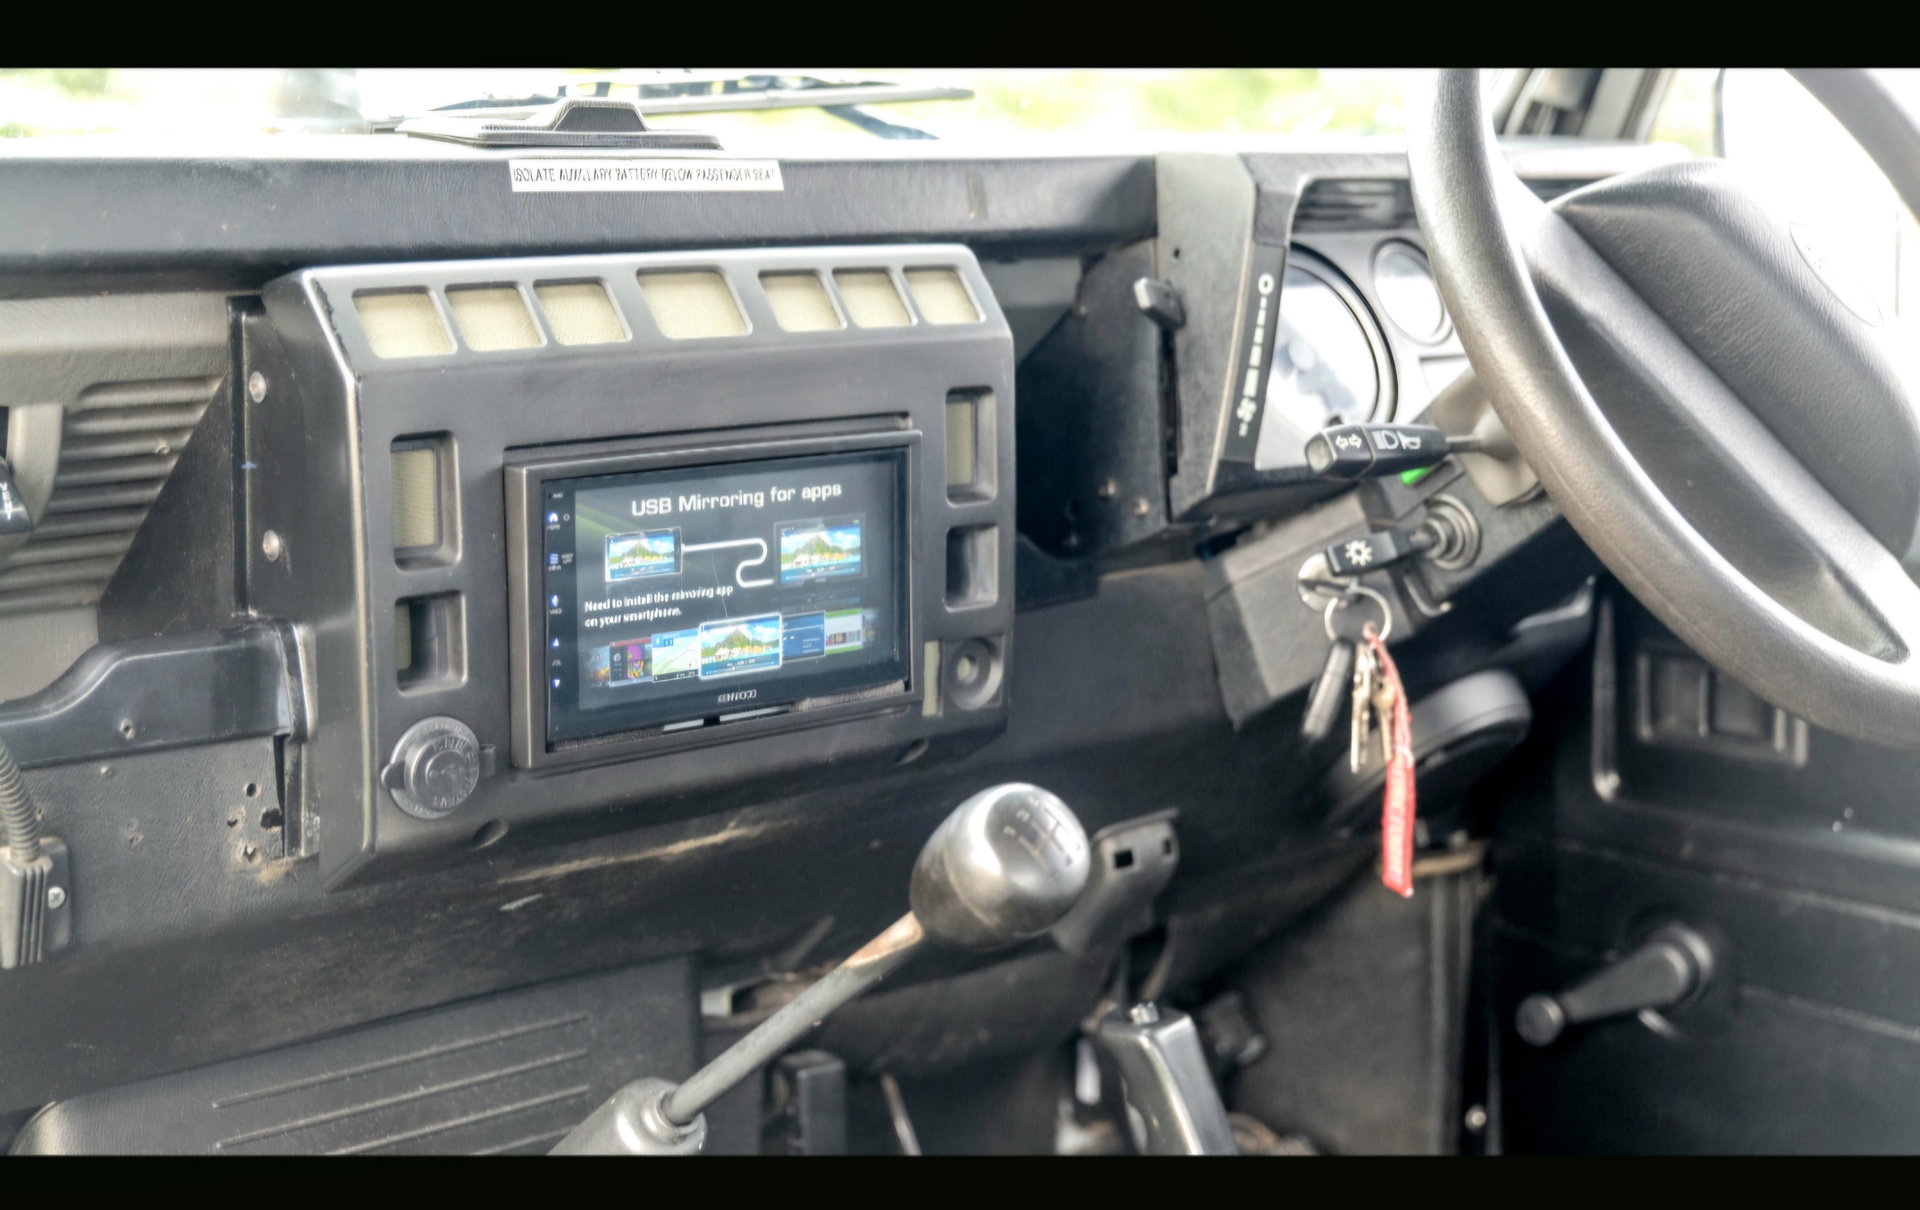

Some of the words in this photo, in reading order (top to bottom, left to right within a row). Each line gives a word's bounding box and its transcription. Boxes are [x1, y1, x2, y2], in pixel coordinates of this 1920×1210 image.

[513, 167, 556, 182] ISOLATE
[615, 167, 658, 182] BATTERY
[632, 497, 672, 516] USB
[678, 489, 764, 512] Mirroring
[770, 486, 796, 502] for
[802, 484, 842, 502] apps
[584, 600, 611, 613] Need
[612, 599, 623, 610] to
[624, 594, 653, 606] install
[654, 591, 669, 602] the
[716, 585, 733, 597] app
[584, 618, 599, 628] on
[600, 615, 622, 629] your
